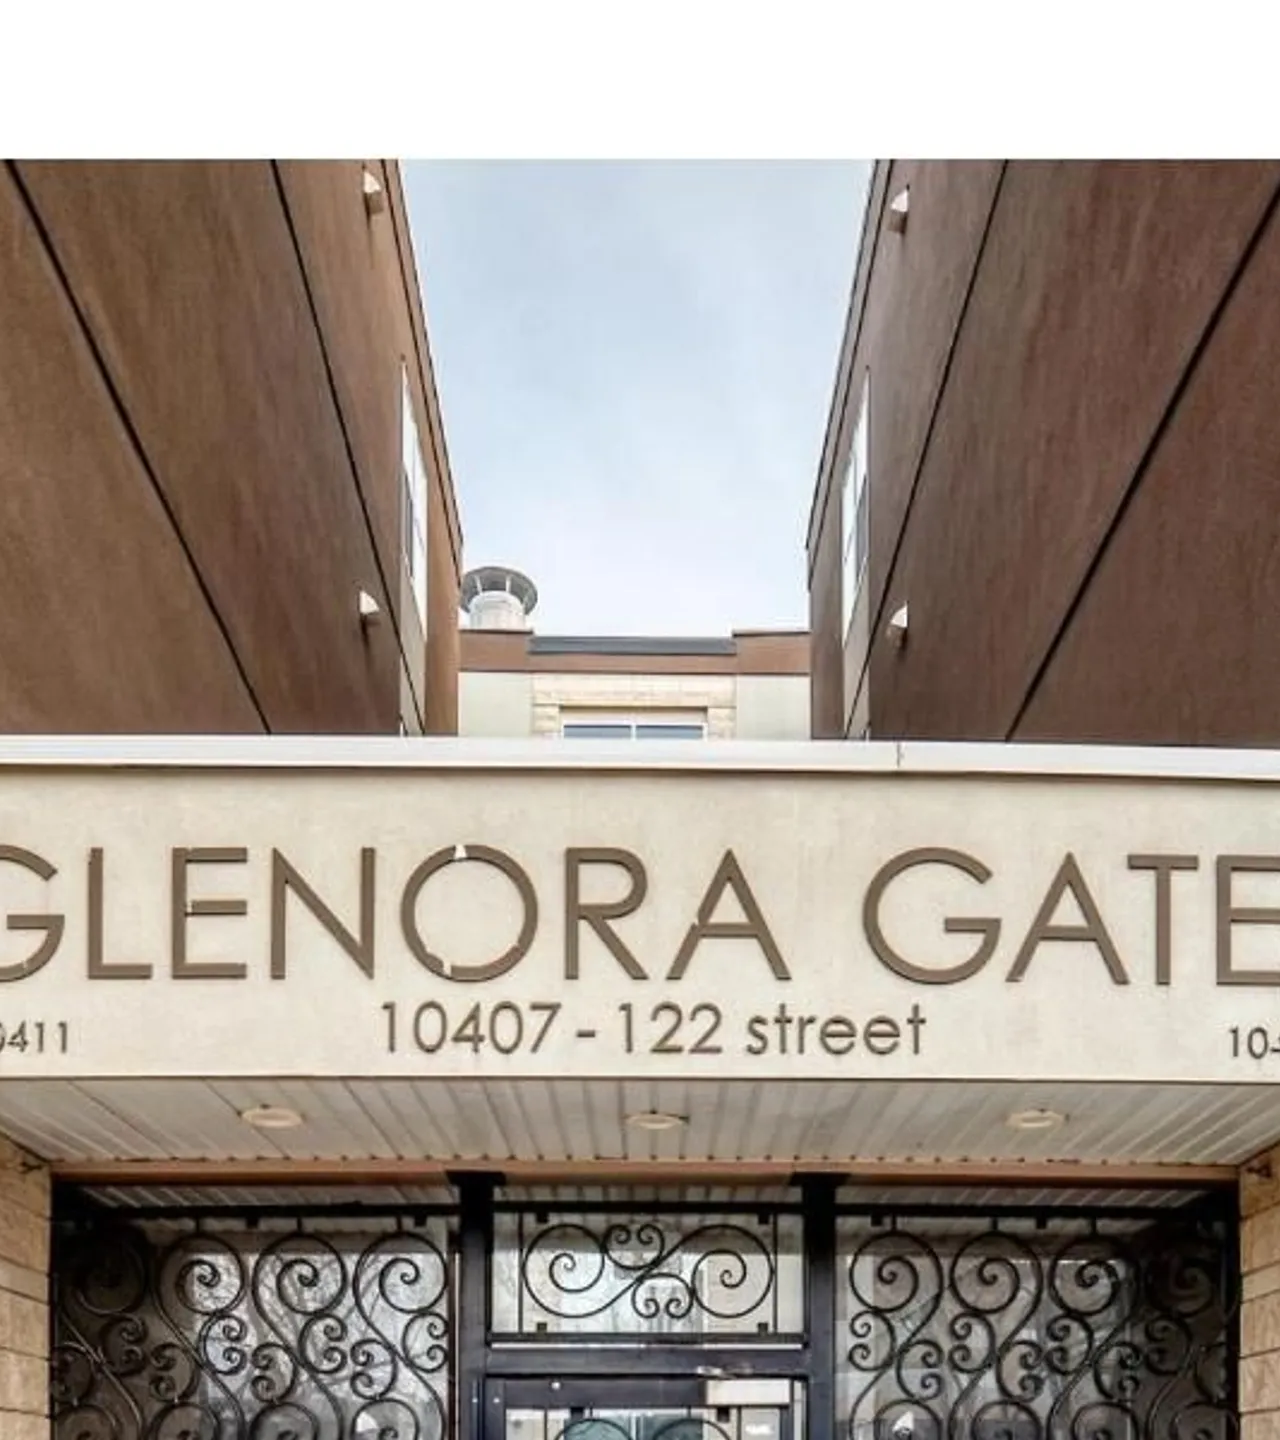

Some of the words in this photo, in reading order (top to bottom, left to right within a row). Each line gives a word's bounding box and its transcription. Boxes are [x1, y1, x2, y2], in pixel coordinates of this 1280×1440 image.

[381, 1000, 563, 1056] 10407
[617, 1001, 723, 1055] 122
[745, 1002, 927, 1056] street
